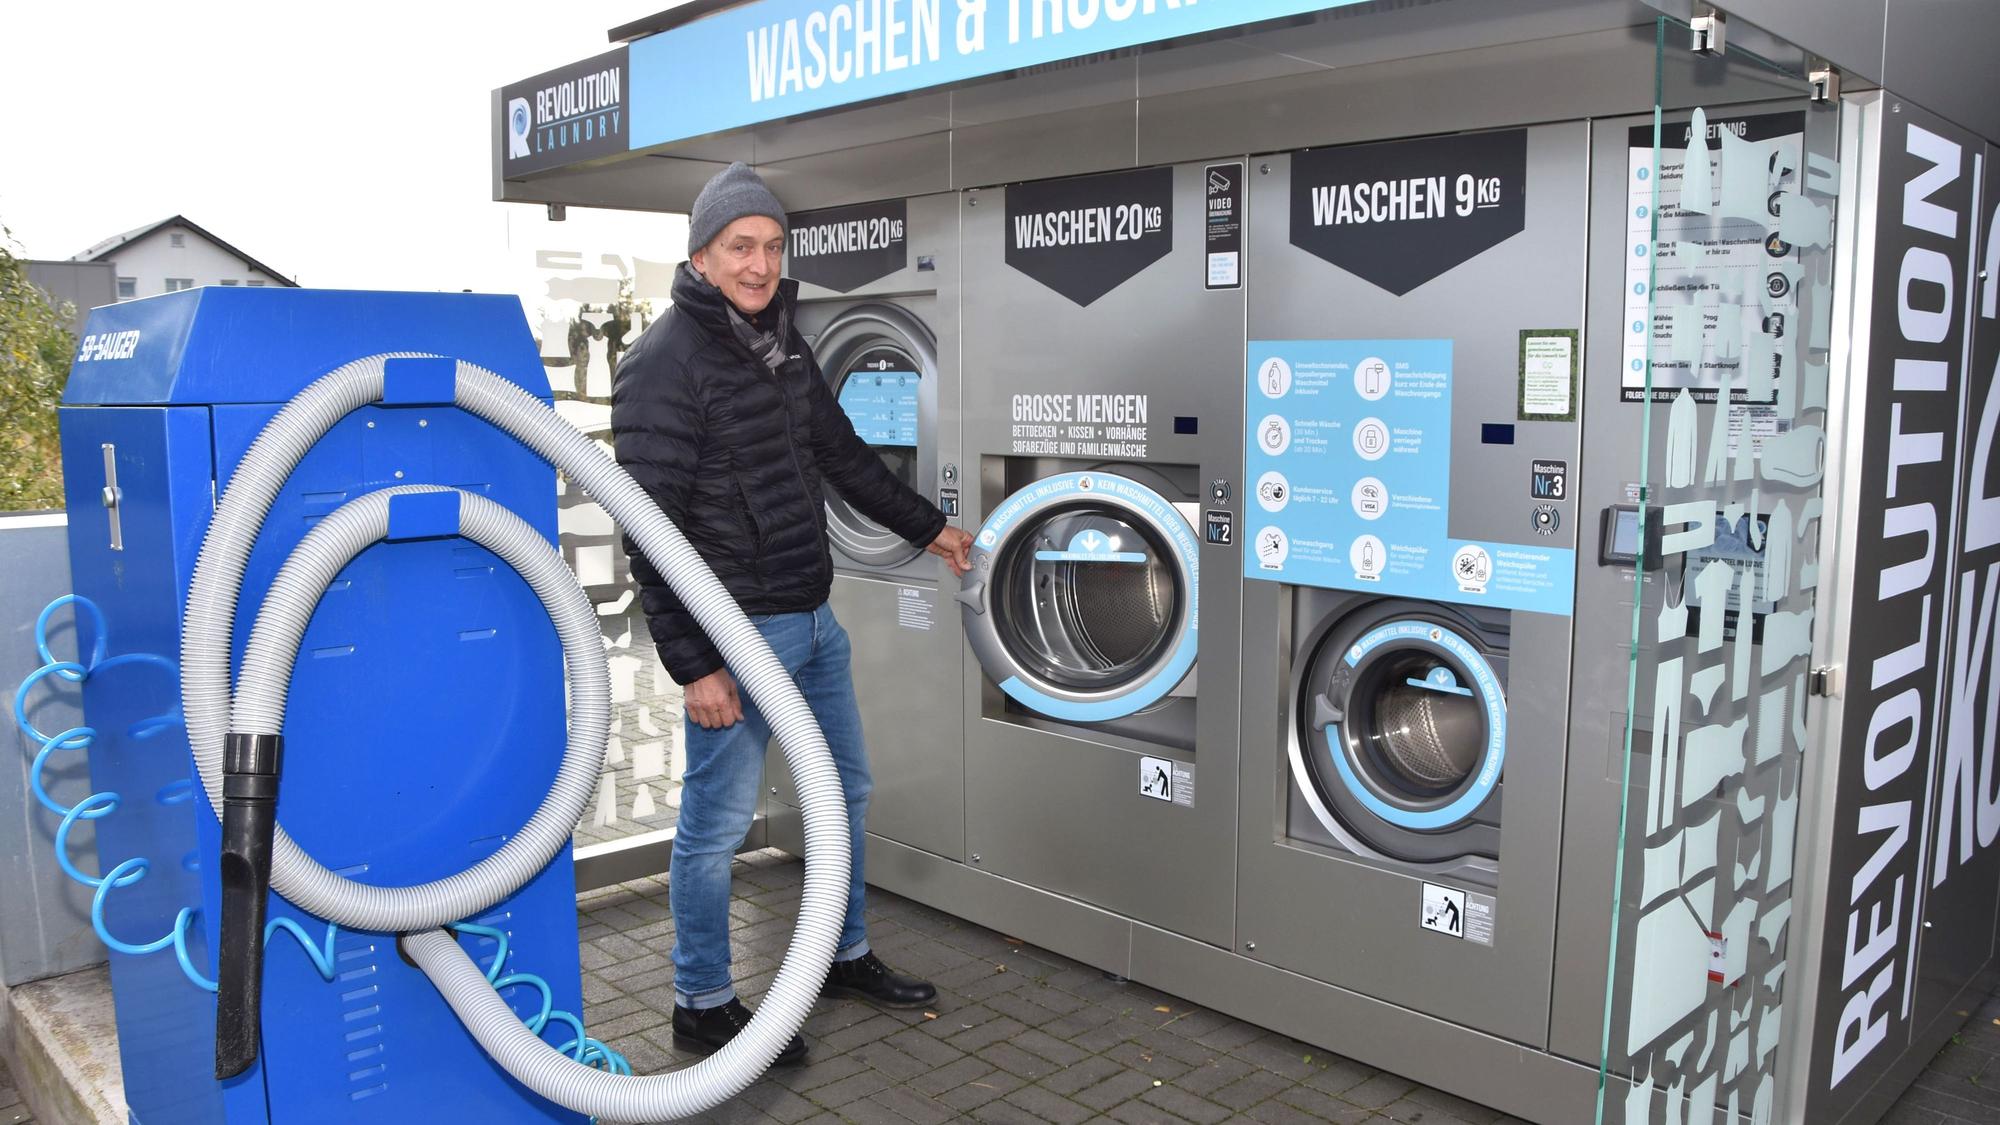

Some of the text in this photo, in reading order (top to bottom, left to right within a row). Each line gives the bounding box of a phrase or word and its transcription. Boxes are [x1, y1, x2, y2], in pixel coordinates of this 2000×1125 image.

[747, 0, 940, 103] WASCHEN
[536, 66, 620, 125] REVOLUTION
[537, 110, 620, 153] LAUNDRY
[1684, 121, 1747, 142] AEITNG
[1208, 197, 1232, 210] VIDEO
[1311, 176, 1446, 226] WASCHEN
[791, 219, 868, 258] TROCKNEN
[1014, 206, 1111, 249] WASCHEN
[1656, 283, 1686, 292] chließen
[1012, 393, 1148, 424] GROSSE MENGEN
[1012, 424, 1147, 441] BETTDECKEN KISSEN VORHÄNGE
[1012, 438, 1147, 458] SOFABEZÜGE UND FAMILIENWÄSCHE
[1533, 463, 1565, 474] Maschine
[1036, 479, 1076, 498] INKLUSIVE
[1097, 479, 1118, 491] KEIN
[1116, 481, 1166, 519] WASCHMITTEL
[1829, 121, 1963, 1092] REVOLUTION
